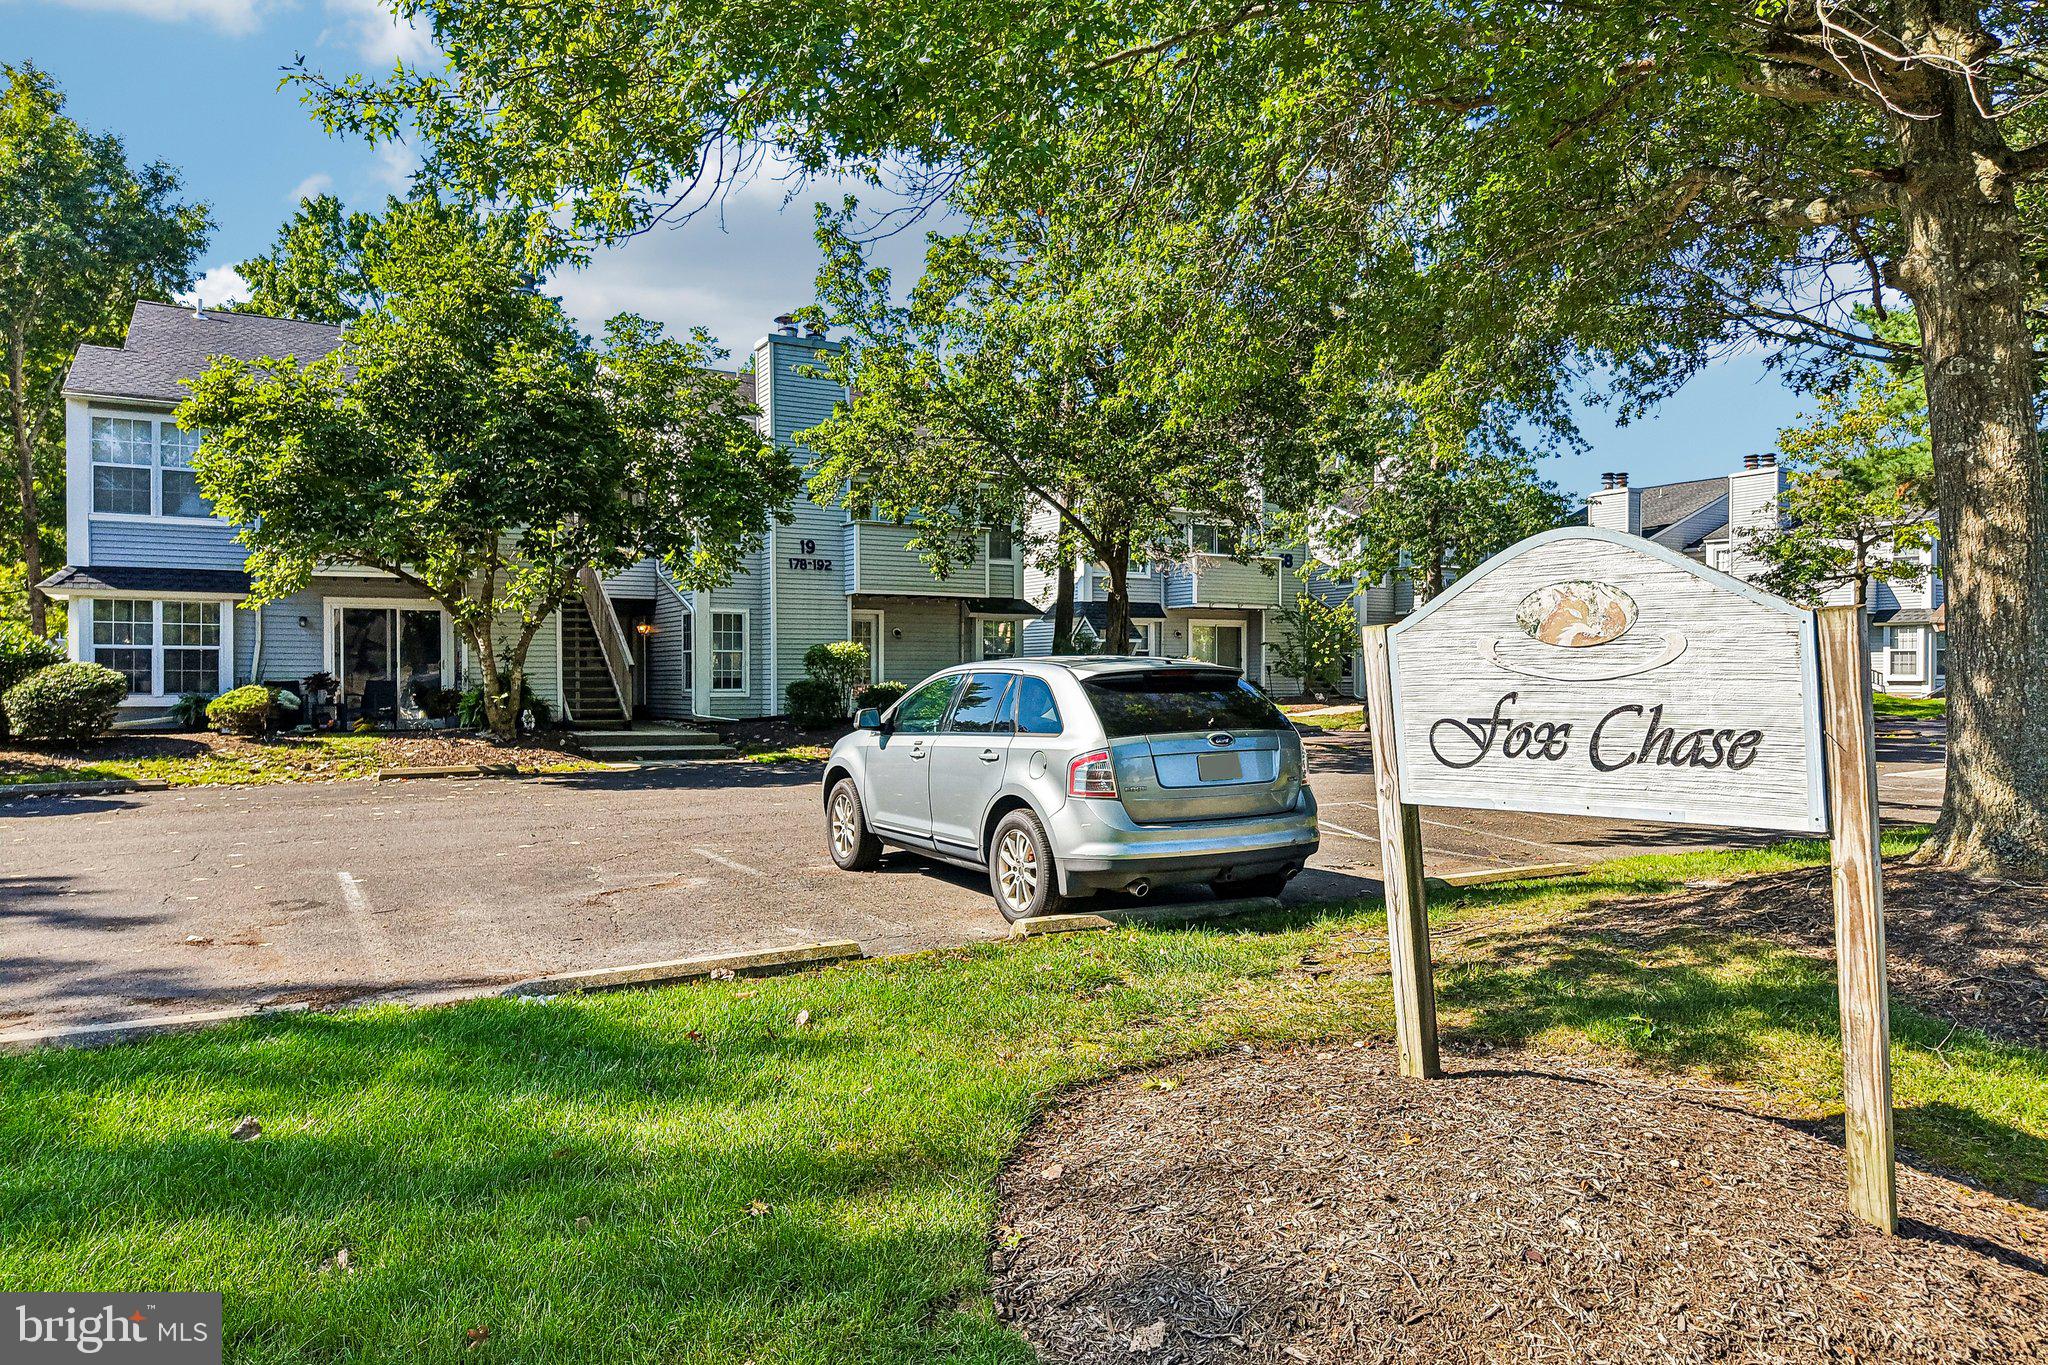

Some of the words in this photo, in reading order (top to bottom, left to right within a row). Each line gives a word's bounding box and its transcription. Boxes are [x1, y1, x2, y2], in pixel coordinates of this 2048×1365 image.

[800, 539, 816, 554] 19
[788, 558, 833, 571] 178-192
[1430, 691, 1574, 769] Fox
[1589, 703, 1765, 773] Chase
